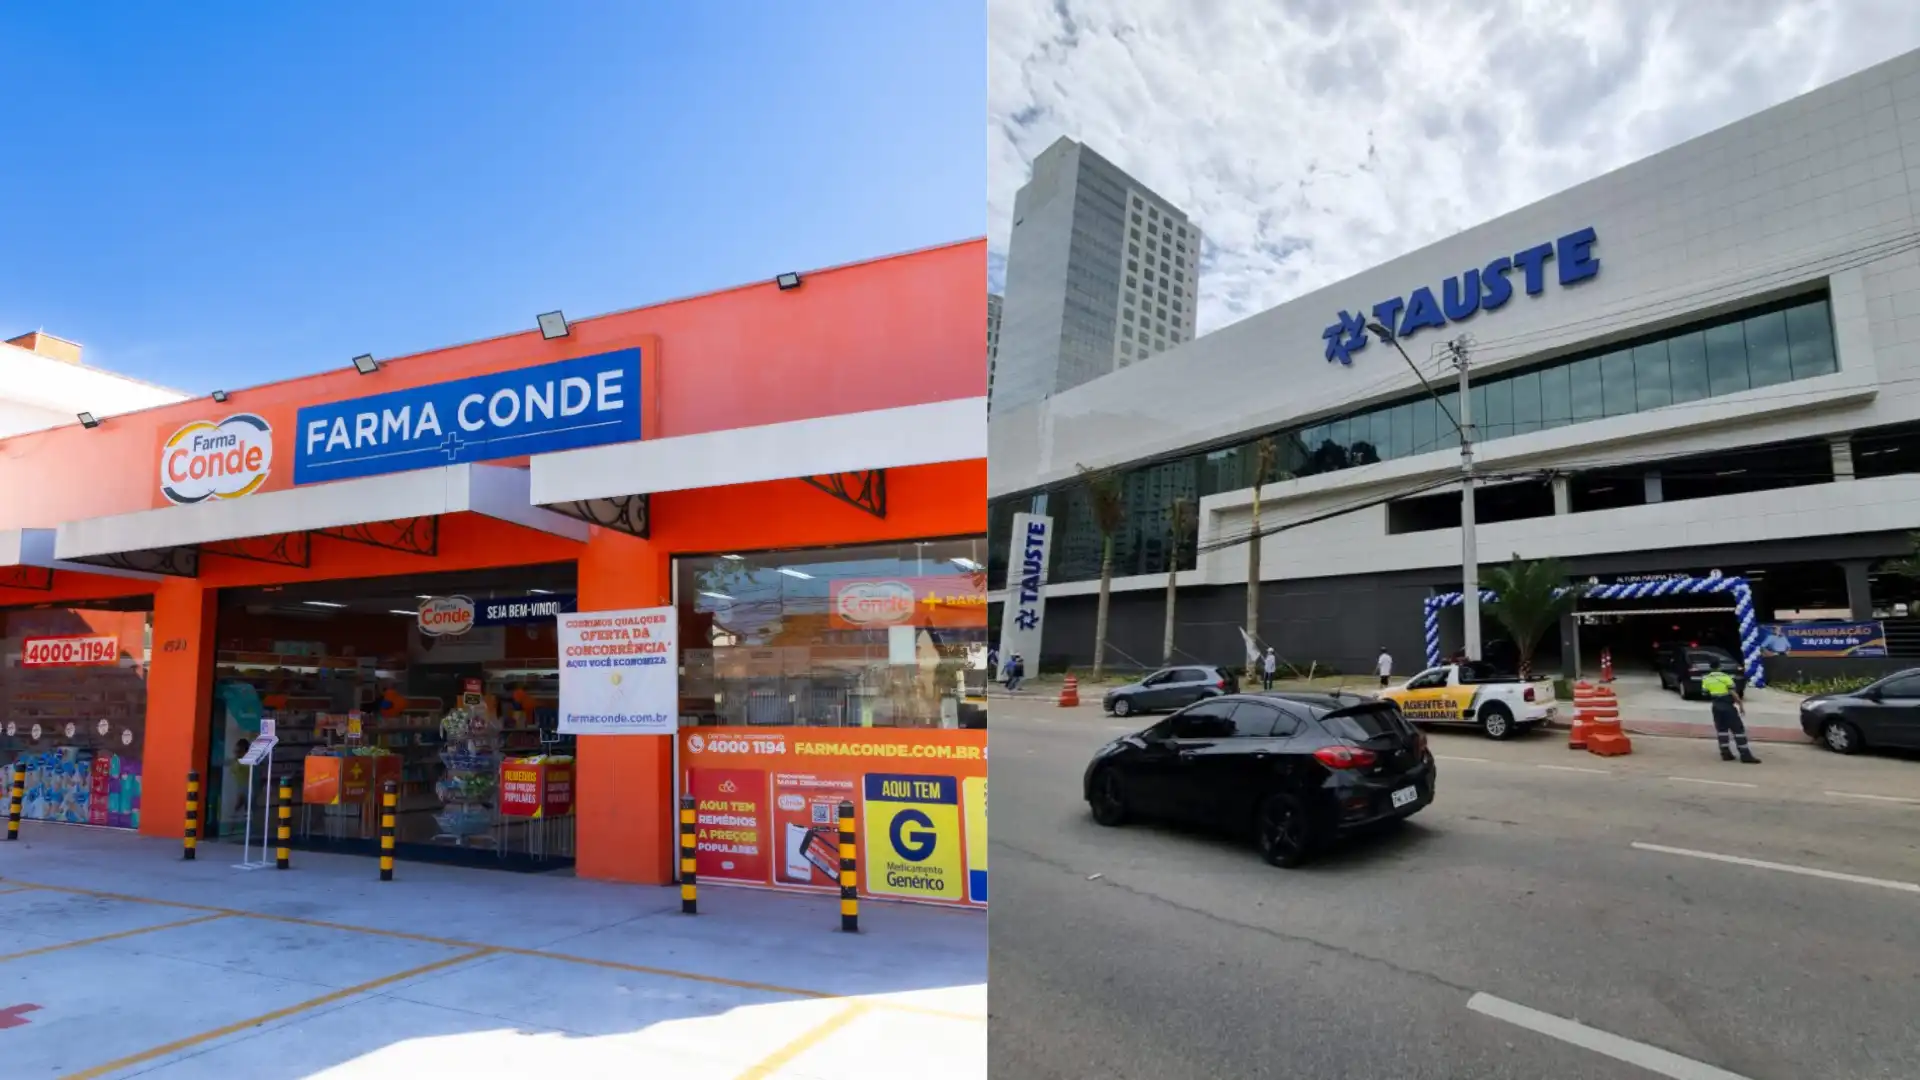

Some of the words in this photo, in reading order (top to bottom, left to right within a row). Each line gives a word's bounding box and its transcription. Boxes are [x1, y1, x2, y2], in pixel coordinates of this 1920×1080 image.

[1372, 226, 1600, 342] TAUSTE
[306, 401, 443, 455] FARMA
[457, 369, 624, 432] CONDE
[193, 434, 236, 452] Farma
[168, 440, 263, 483] Conde
[1020, 522, 1045, 605] TAUSTE
[487, 604, 507, 619] SEJA
[842, 594, 909, 614] Conde
[421, 608, 471, 625] Conde
[614, 614, 666, 627] QUALQUER
[580, 629, 630, 641] OFERTA
[632, 627, 650, 639] DA
[29, 641, 115, 662] 4000-1194
[566, 659, 588, 668] AQUI
[589, 657, 612, 667] VOCÊ
[613, 656, 667, 667] ECONOMIZA
[1403, 700, 1446, 709] AGENTE
[1446, 700, 1458, 709] DA
[567, 712, 668, 724] farmaconde.com.br
[707, 740, 749, 754] 4000
[752, 740, 787, 755] 1194
[794, 742, 980, 760] FARMACONDE.COM.BR
[882, 780, 911, 798] AQUI
[913, 782, 941, 799] TEM
[700, 800, 728, 811] AQUI
[730, 802, 755, 813] TEM
[698, 814, 757, 827] REMÉDIOS
[710, 829, 757, 842] PREÇOS
[889, 808, 937, 862] G
[698, 842, 758, 855] POPULARES
[887, 862, 943, 875] Medicamento
[887, 871, 944, 891] Genérico
